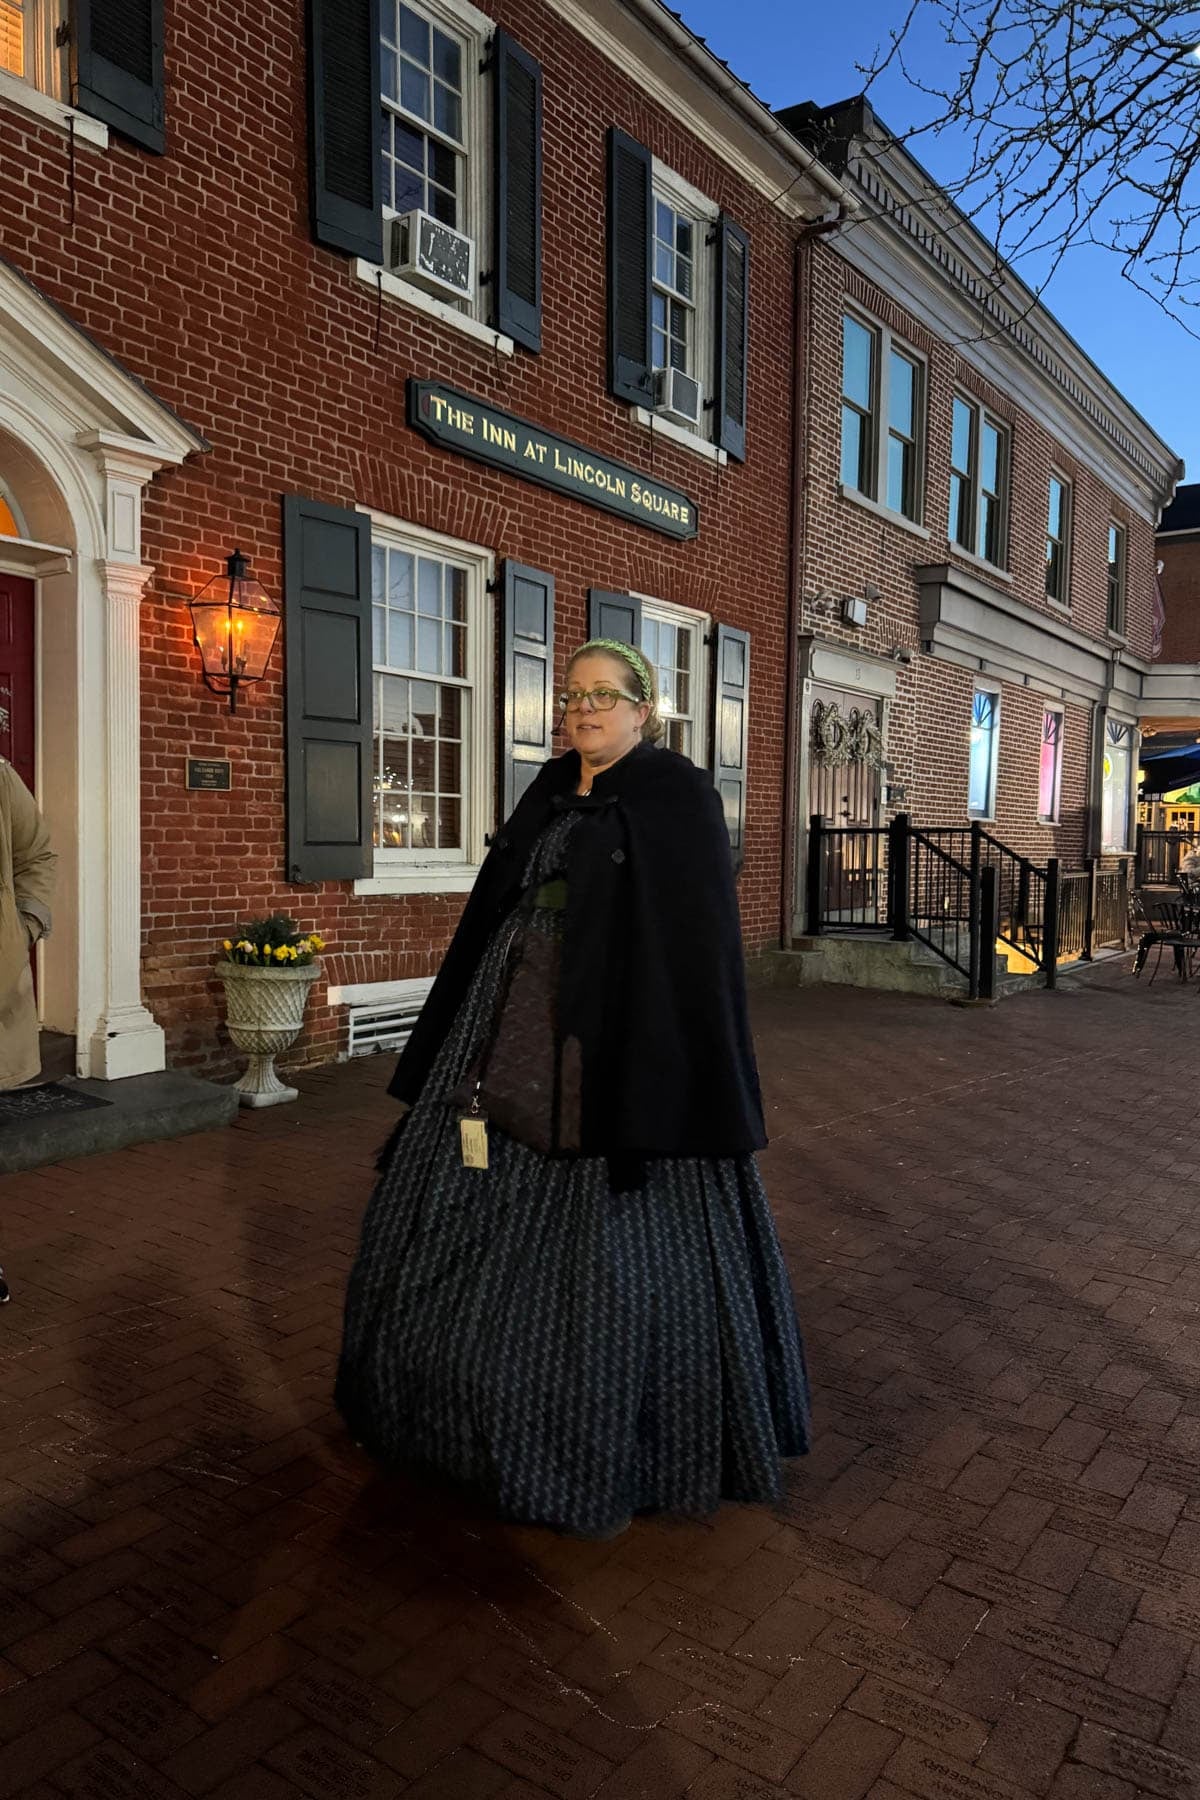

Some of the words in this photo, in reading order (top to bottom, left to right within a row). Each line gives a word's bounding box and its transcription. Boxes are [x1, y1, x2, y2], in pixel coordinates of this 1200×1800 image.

[430, 395, 475, 435] THE
[482, 418, 516, 453] INN
[523, 439, 547, 464] AT
[554, 449, 626, 498] LINCOLN
[631, 482, 690, 525] SQUARE
[1005, 1627, 1043, 1646] JOHN
[1022, 1623, 1074, 1647] KAISER
[1046, 1643, 1081, 1661] PAUL
[877, 1685, 970, 1730] LONGSTREET
[698, 1707, 774, 1747] MCFADDEN
[718, 1732, 754, 1754] RYAN
[918, 1756, 1014, 1800] ONGBERRY
